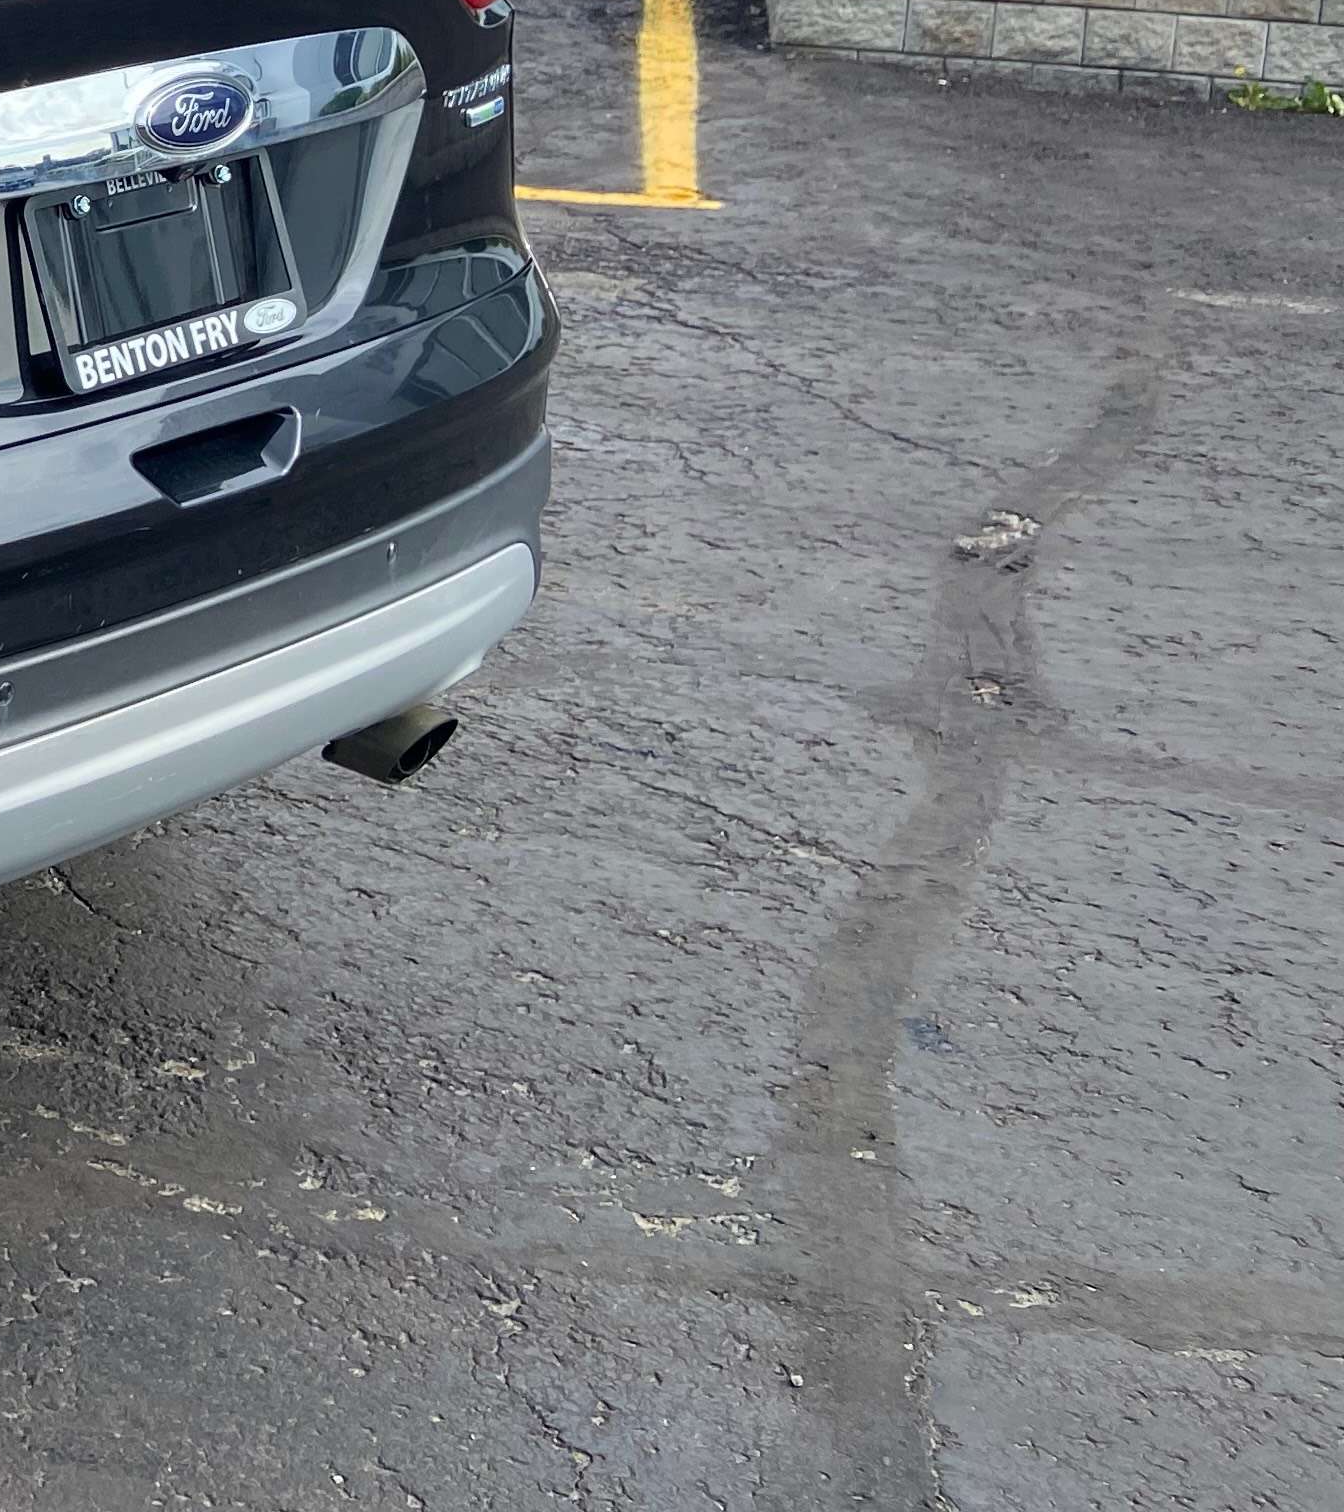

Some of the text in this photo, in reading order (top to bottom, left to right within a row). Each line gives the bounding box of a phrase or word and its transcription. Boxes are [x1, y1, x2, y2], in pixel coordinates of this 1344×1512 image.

[172, 91, 231, 136] Ford
[106, 170, 167, 196] BELLEVIL
[255, 305, 285, 328] Ford
[75, 310, 240, 390] BENTON FRY
